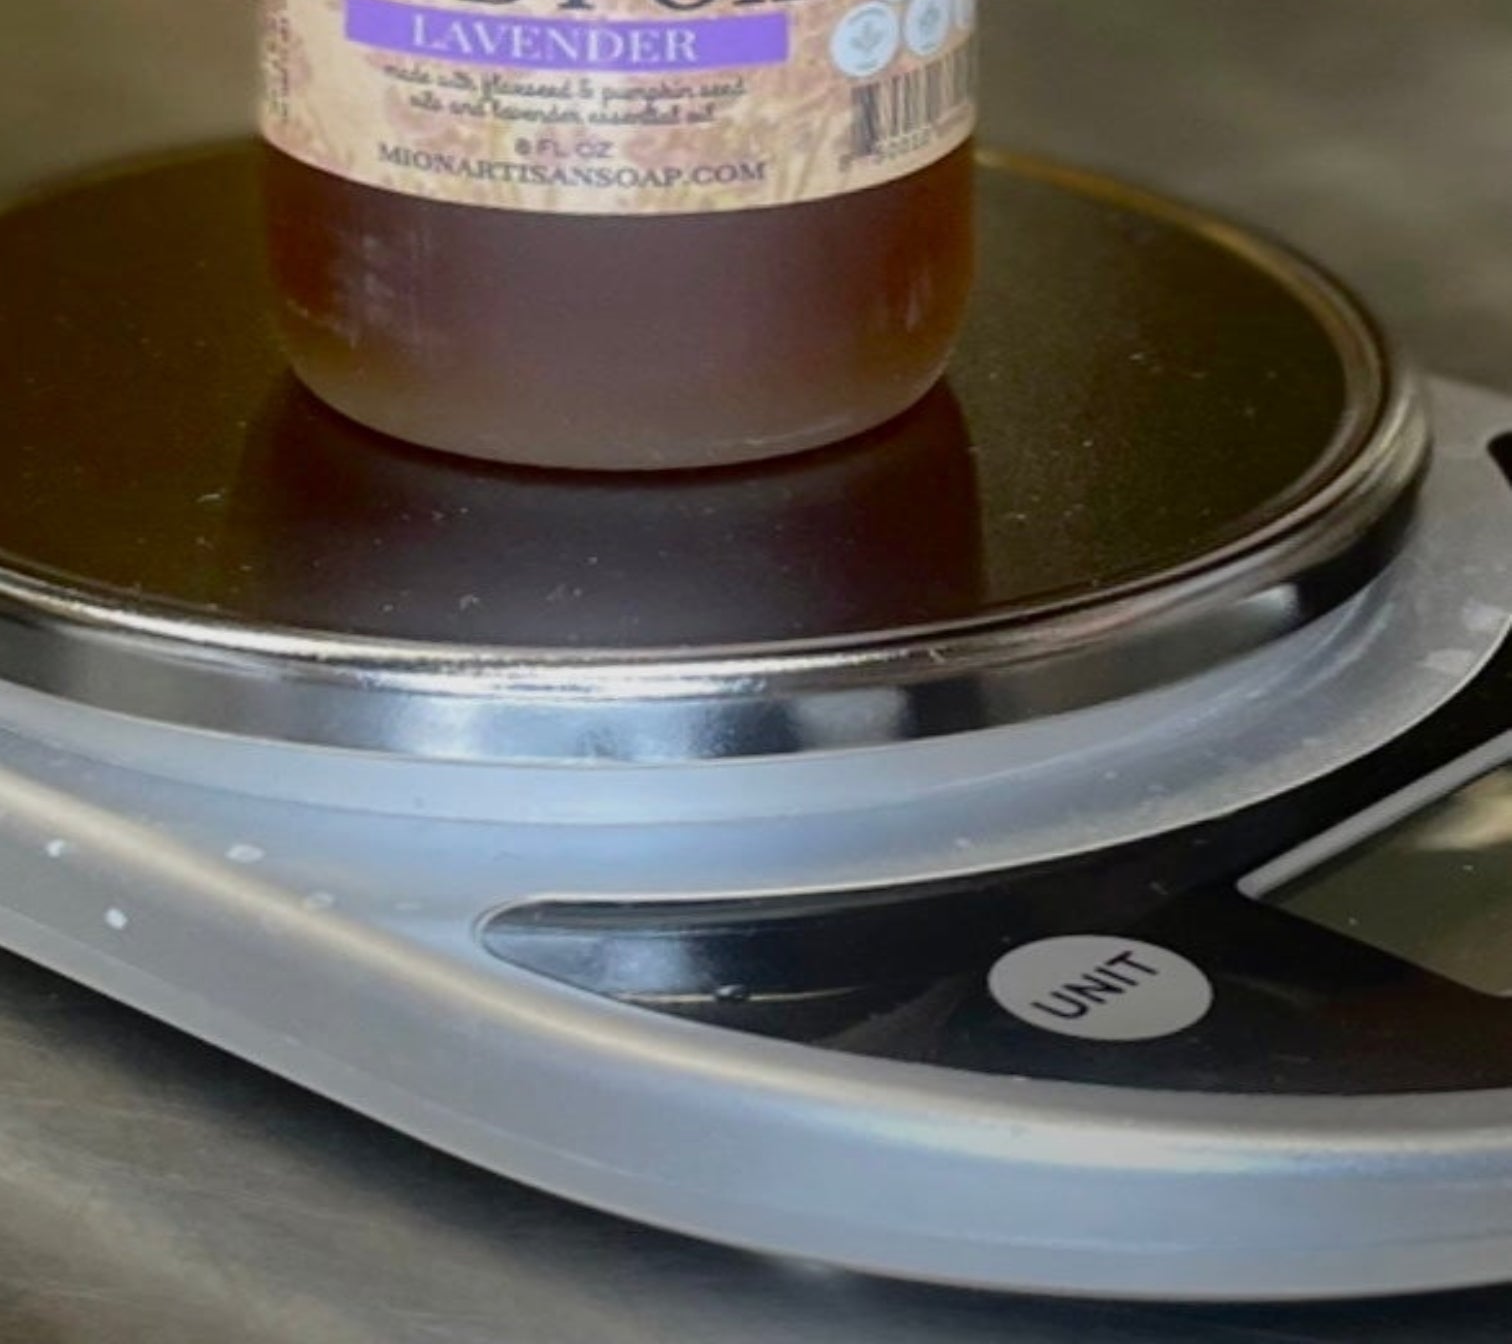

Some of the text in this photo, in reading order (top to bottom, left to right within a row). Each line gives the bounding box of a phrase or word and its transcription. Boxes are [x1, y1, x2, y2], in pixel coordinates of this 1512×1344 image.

[411, 14, 698, 65] LAVENDER
[379, 141, 766, 186] MIONARTISANSOAP.COM
[1030, 950, 1160, 1020] UNIT
